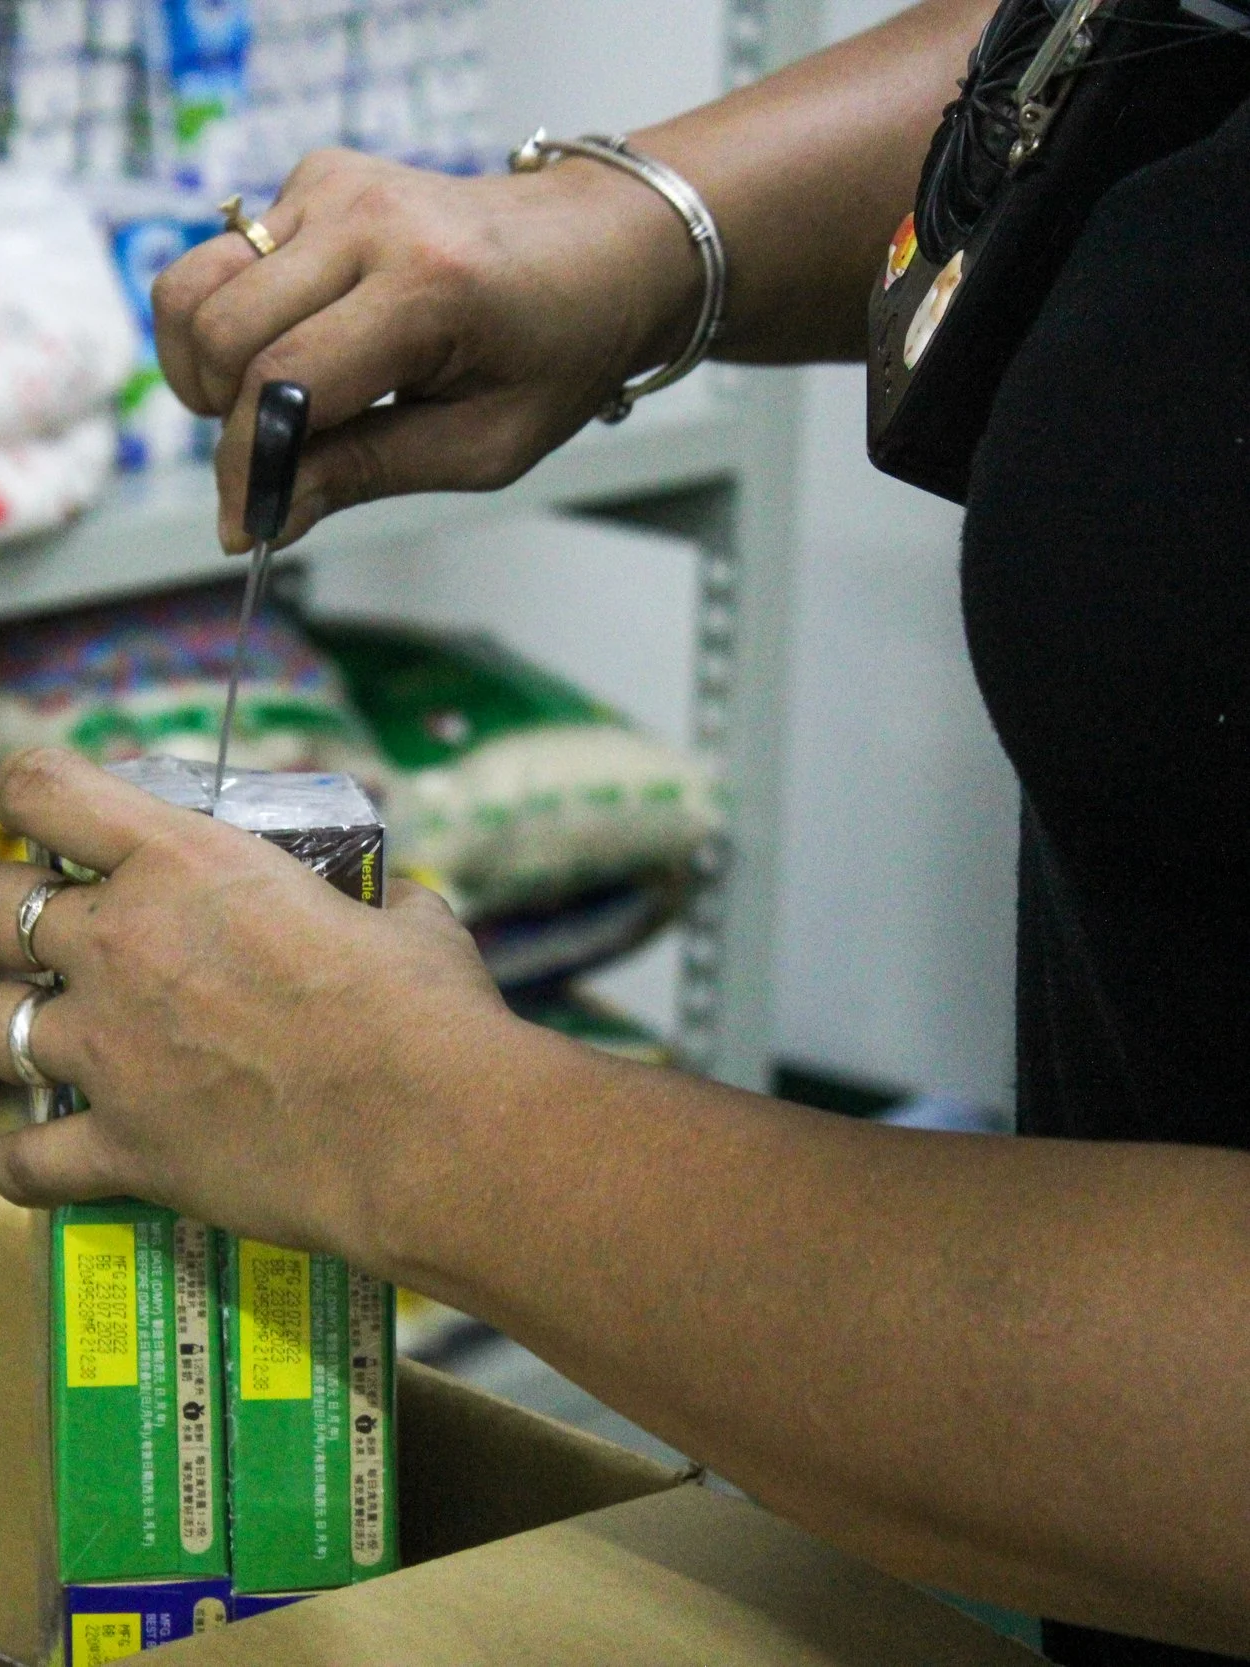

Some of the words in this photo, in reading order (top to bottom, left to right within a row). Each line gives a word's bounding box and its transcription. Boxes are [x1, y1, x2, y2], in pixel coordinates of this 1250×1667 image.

[361, 854, 374, 900] Nestlé
[112, 1255, 127, 1279] MFG
[137, 1250, 148, 1289] BEFORE
[151, 1250, 163, 1277] DATE
[287, 1259, 300, 1286] MFG
[118, 1624, 131, 1648] MFG
[145, 1613, 157, 1640] BEST
